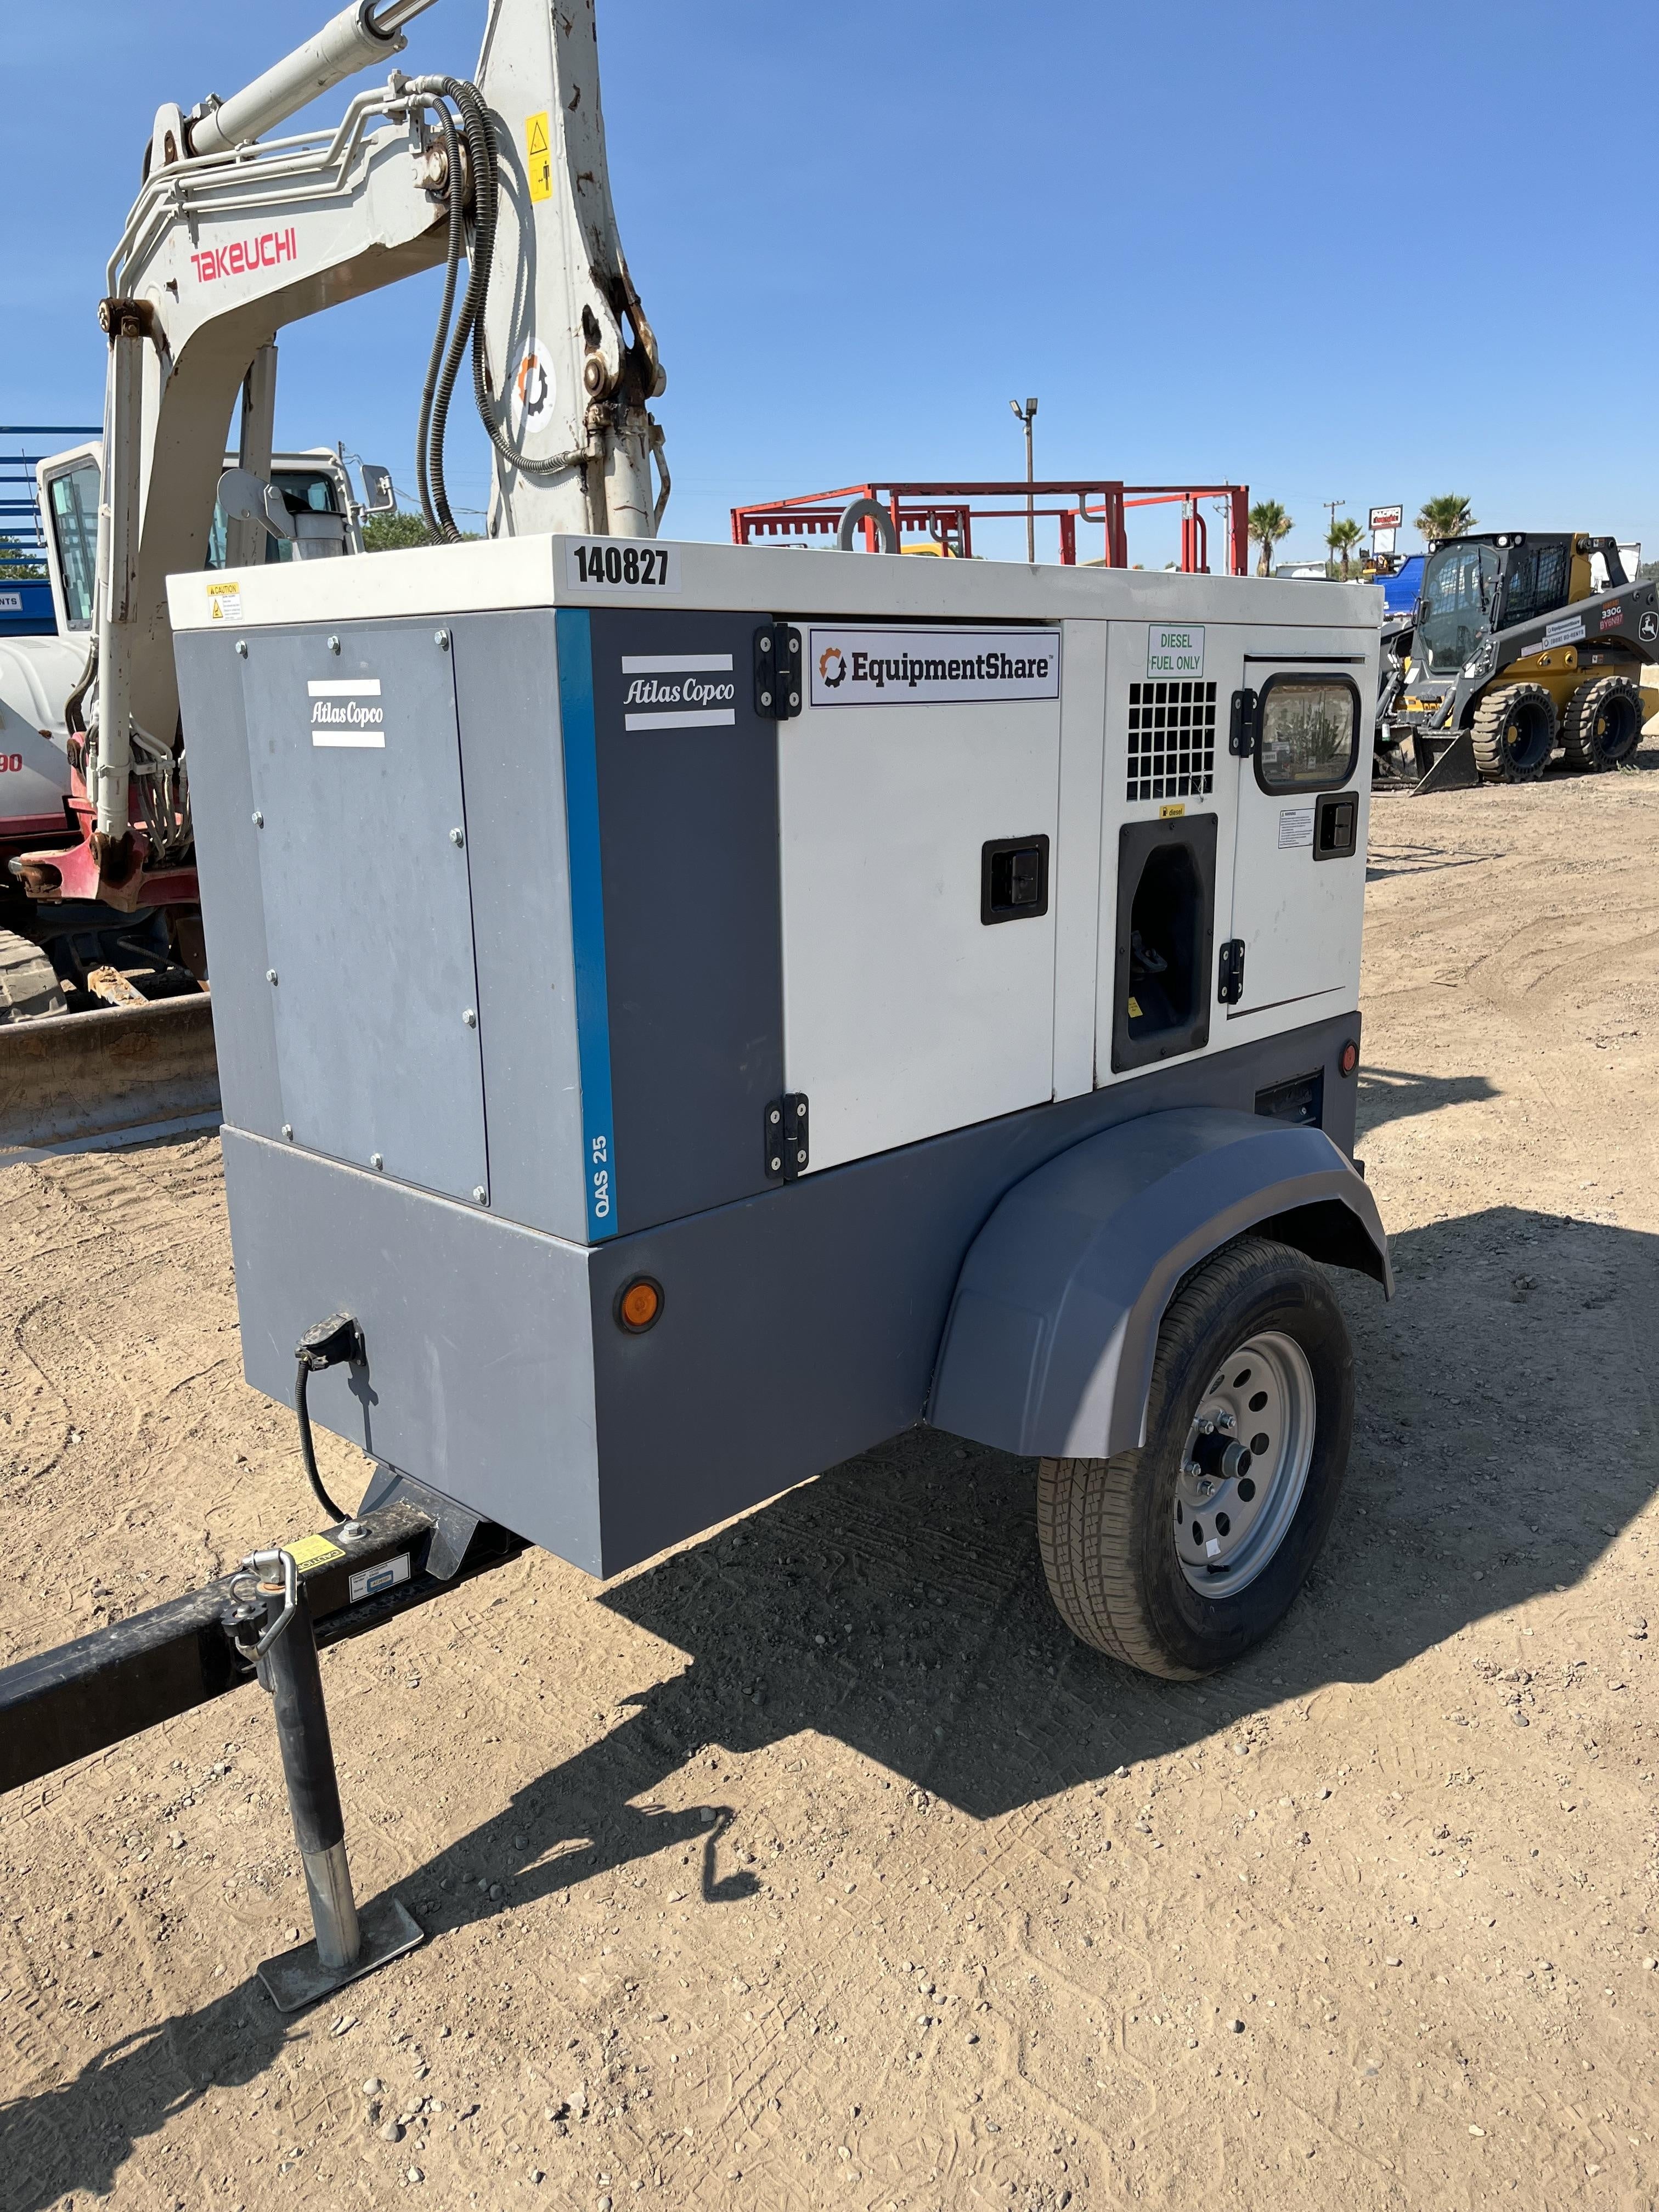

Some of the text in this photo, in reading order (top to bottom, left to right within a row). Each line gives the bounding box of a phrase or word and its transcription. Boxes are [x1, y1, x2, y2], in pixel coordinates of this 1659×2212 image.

[573, 545, 669, 585] 140827
[215, 585, 236, 594] CAUTION
[1601, 606, 1622, 619] 330G
[1161, 633, 1193, 648] DIESEL
[852, 652, 1048, 687] EquipmentShare
[1151, 656, 1200, 670] FUEL ONLY
[0, 753, 22, 773] 90
[1169, 808, 1183, 816] diesel
[592, 1135, 610, 1218] QAS 25
